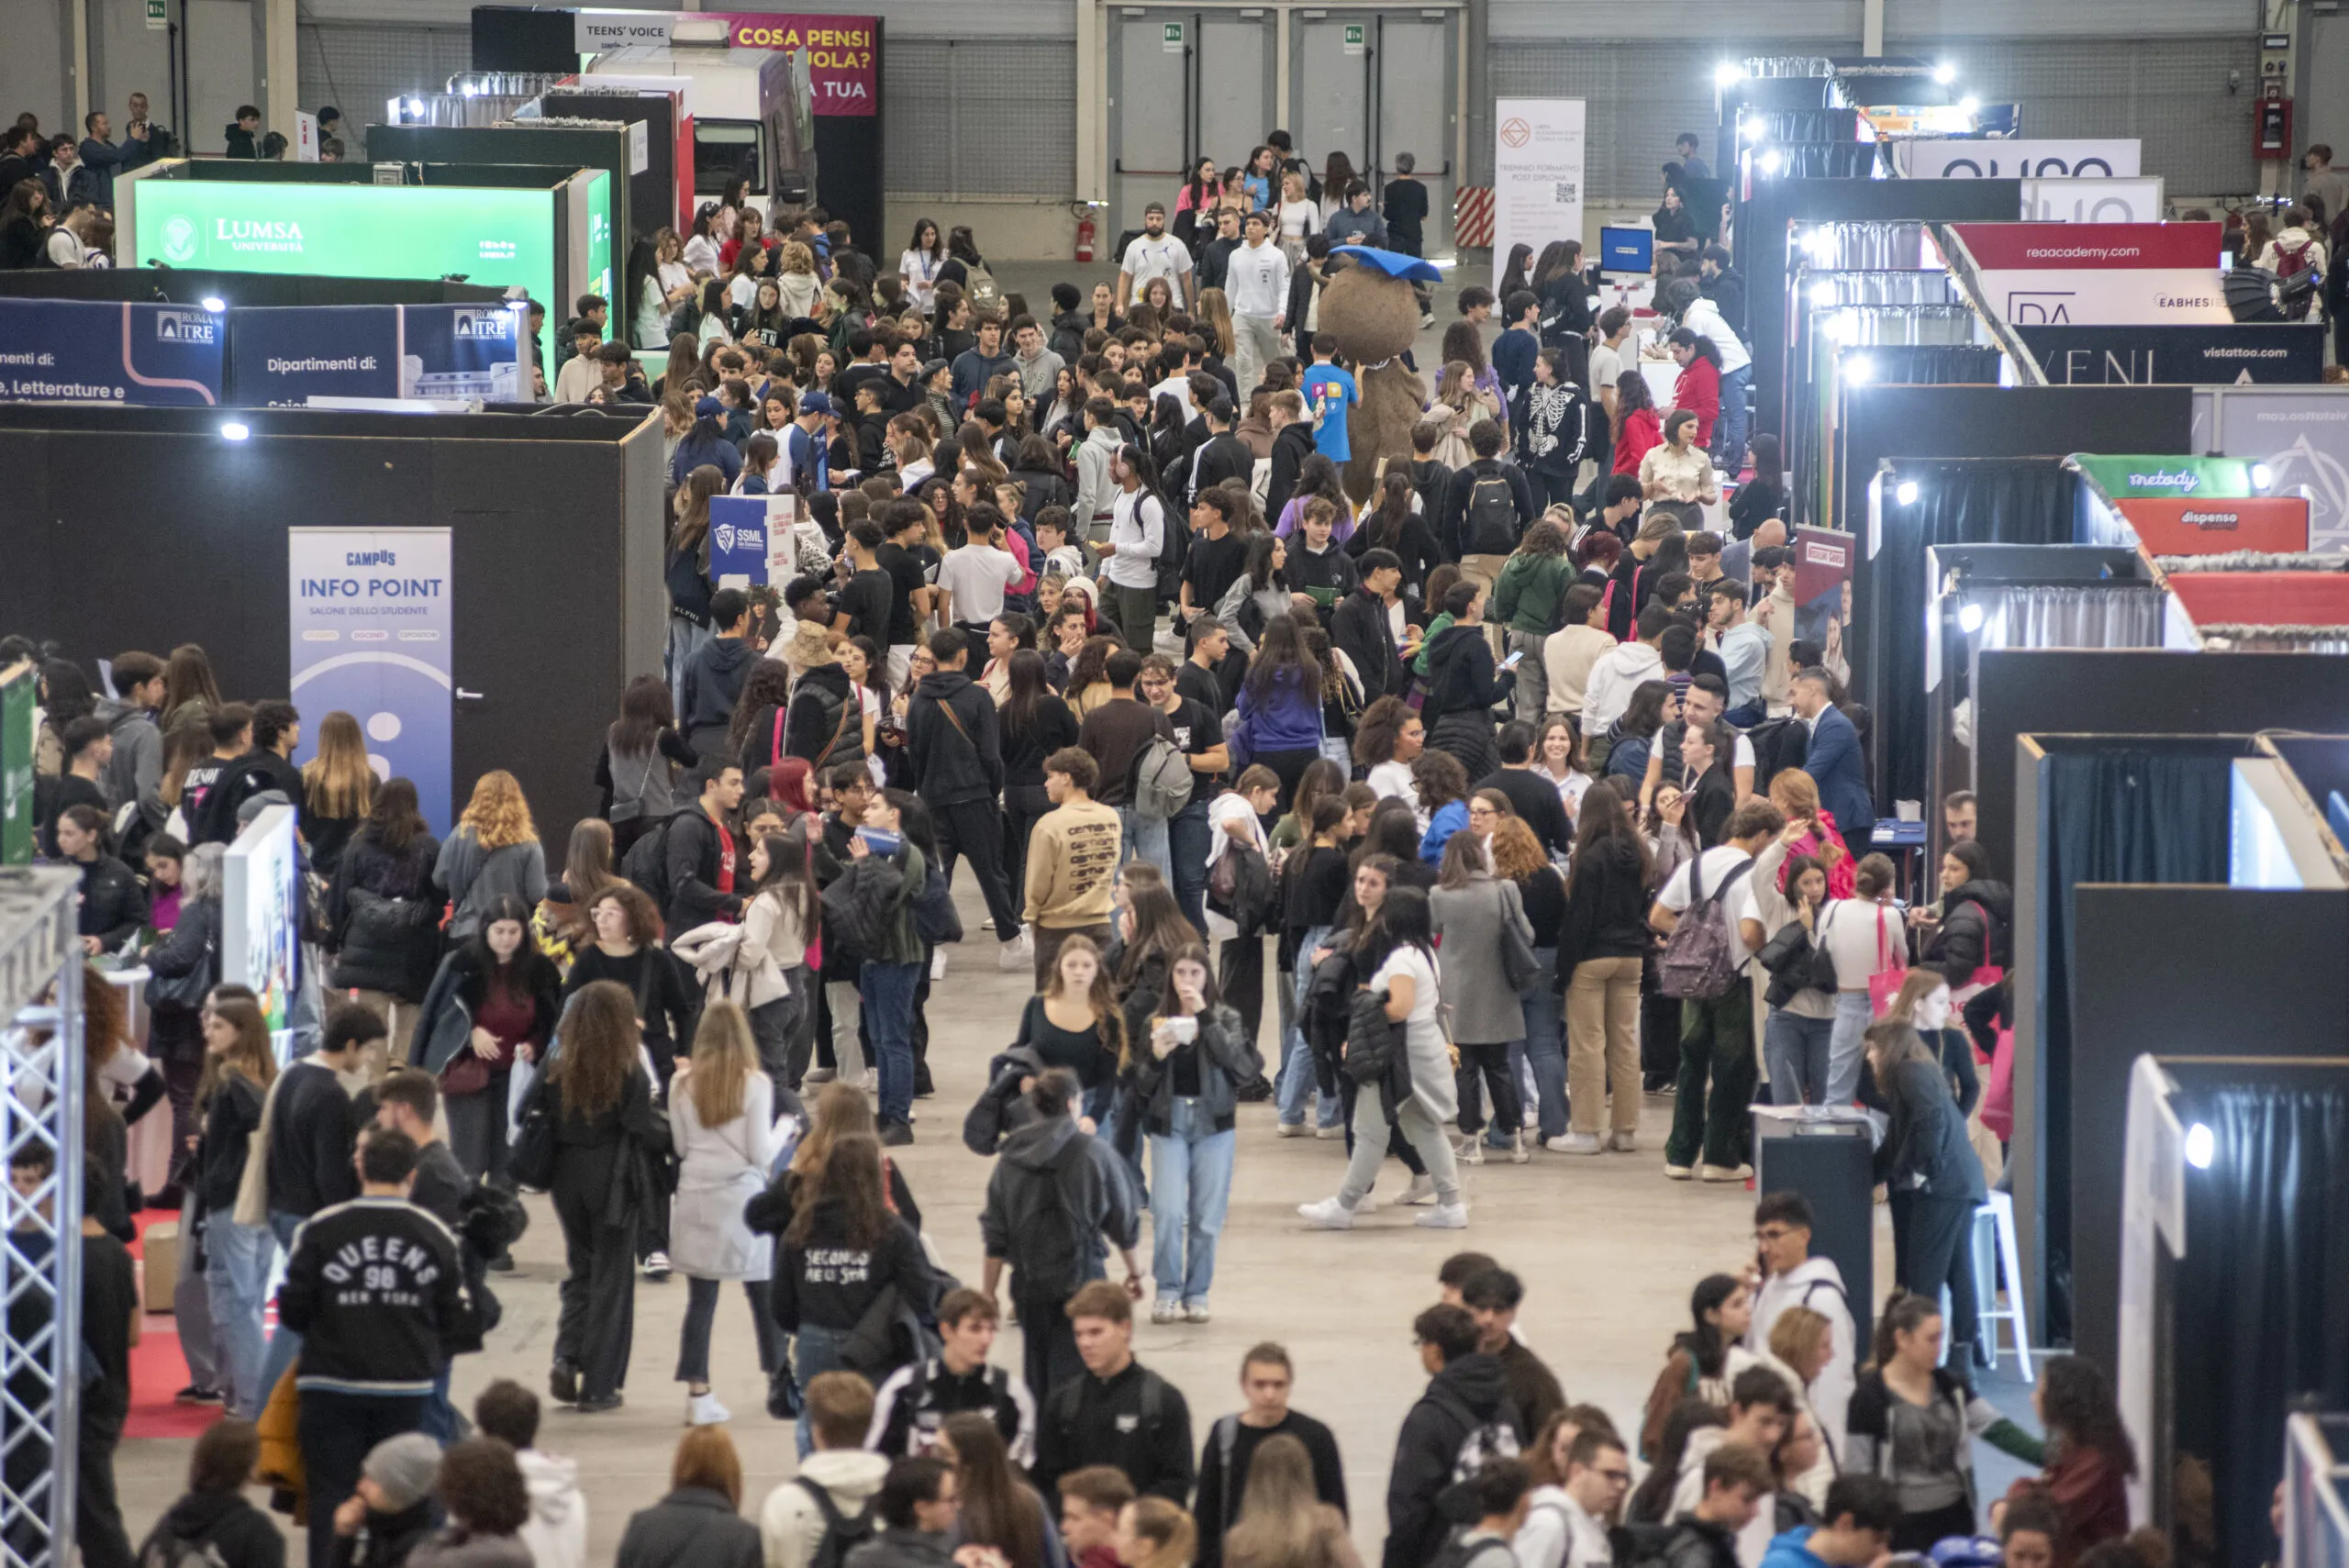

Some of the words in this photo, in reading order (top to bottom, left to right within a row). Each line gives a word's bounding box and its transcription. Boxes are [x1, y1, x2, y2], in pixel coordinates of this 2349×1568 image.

[629, 27, 664, 38] VOICE
[738, 28, 800, 45] COSA
[807, 29, 870, 47] PENSI
[823, 82, 867, 98] TUA
[1537, 164, 1581, 172] FORMATIVO
[1533, 173, 1567, 182] DIPLOMA
[216, 217, 304, 240] LUMSA
[2026, 246, 2140, 260] reaacademy.com
[2159, 297, 2210, 307] EABHES
[183, 312, 213, 324] ROMA
[182, 325, 214, 339] TRE
[475, 321, 506, 335] TRE
[38, 353, 54, 365] di:
[2203, 347, 2288, 358] vistattoo.com
[267, 356, 357, 374] Dipartimenti
[360, 355, 377, 370] di:
[13, 380, 111, 398] Letterature
[114, 387, 125, 399] e
[2181, 511, 2238, 525] dispenso
[737, 528, 763, 542] SSML
[301, 579, 360, 597] INFO
[369, 579, 442, 597] POINT
[309, 606, 345, 616] SALONE
[349, 606, 378, 616] DELLO
[381, 606, 428, 616] STUDENTE
[322, 1235, 439, 1285] QUEENS
